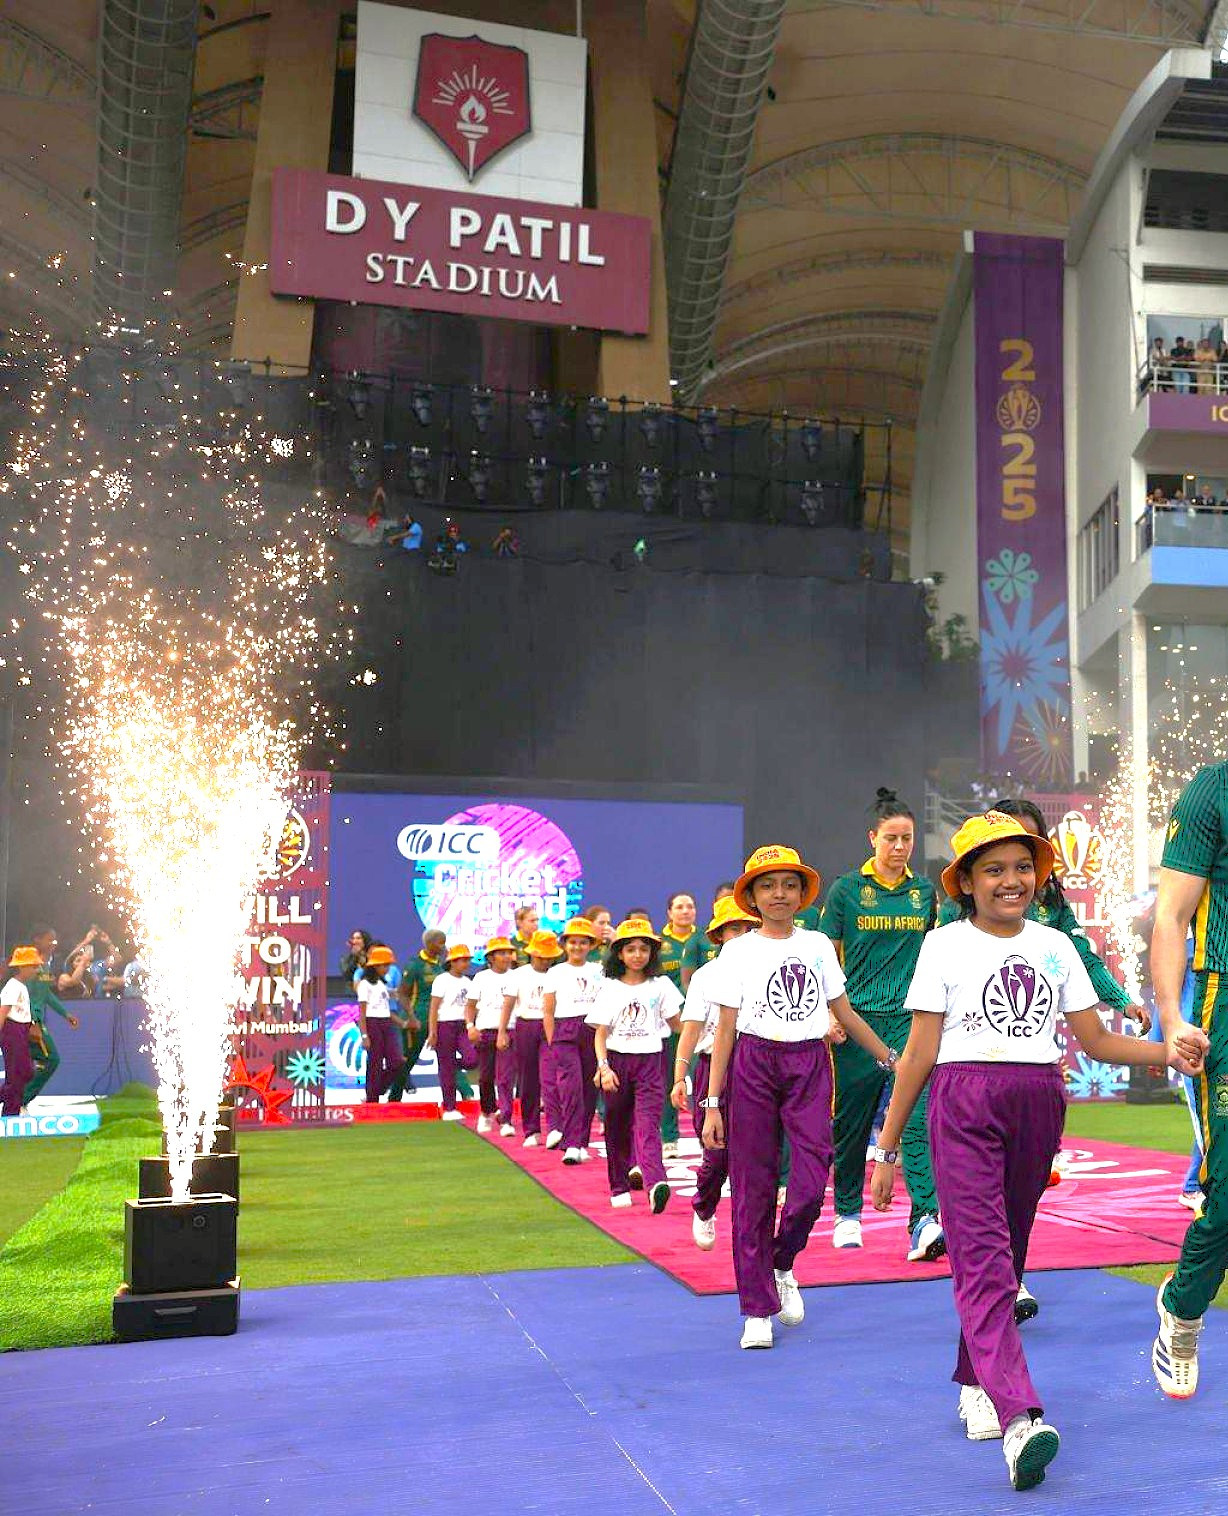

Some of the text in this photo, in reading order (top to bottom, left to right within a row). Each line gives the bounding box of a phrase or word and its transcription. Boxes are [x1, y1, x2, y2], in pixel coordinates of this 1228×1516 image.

[325, 190, 606, 266] D Y PATIL
[365, 252, 563, 304] STADIUM
[437, 831, 485, 854] ICC
[857, 915, 925, 931] SOUTH AFRIC
[786, 1011, 805, 1022] ICC
[1007, 1025, 1033, 1038] ICC
[0, 1114, 79, 1137] mco
